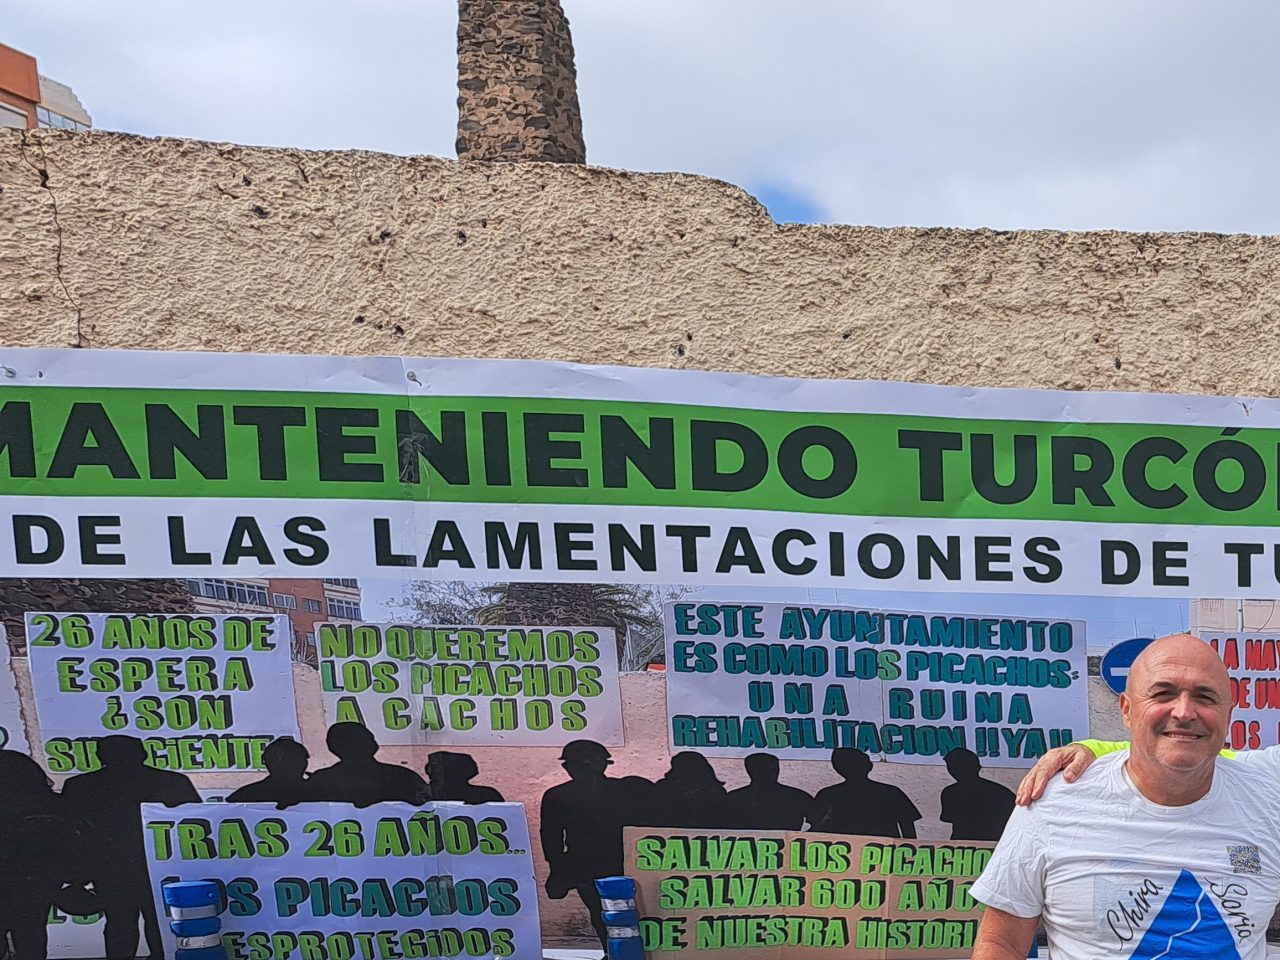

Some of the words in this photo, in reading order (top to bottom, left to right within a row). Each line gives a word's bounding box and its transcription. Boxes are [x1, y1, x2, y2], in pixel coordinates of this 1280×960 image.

[12, 514, 126, 565] DE
[167, 515, 331, 567] LAS
[373, 517, 1063, 583] LAMENTACIONES
[1101, 540, 1189, 587] DE
[30, 613, 94, 649] 26
[102, 613, 216, 650] AÑOS
[223, 616, 277, 651] DE
[319, 624, 382, 659] NO
[385, 625, 601, 663] QUEREMOS
[674, 604, 764, 638] ESTE
[780, 607, 1073, 653] AYUNTAMIENTO
[57, 657, 254, 692] ESPERA
[321, 660, 399, 693] LOS
[410, 662, 604, 697] PICACHOS
[674, 641, 718, 673] ES
[723, 644, 829, 678] COMO
[835, 647, 902, 681] LOS
[101, 695, 233, 730] ¿SON
[382, 697, 588, 731] CACHOS
[747, 681, 850, 716] UNA
[889, 687, 1033, 725] RUINA
[673, 715, 966, 756] REHABILITACION
[147, 818, 289, 861] TRAS
[303, 819, 366, 857] 26
[635, 834, 785, 873] SALVAR
[789, 838, 851, 873] LOS
[860, 842, 995, 878] PICACHO
[274, 876, 522, 918] PICACHOS
[660, 875, 804, 910] SALVAR
[811, 878, 885, 911] 600
[897, 877, 986, 912] AÑO
[1203, 877, 1256, 944] Soria
[639, 917, 688, 952] DE
[696, 916, 849, 951] NUESTRA
[856, 918, 978, 950] HISTORI
[1106, 878, 1164, 952] Chira
